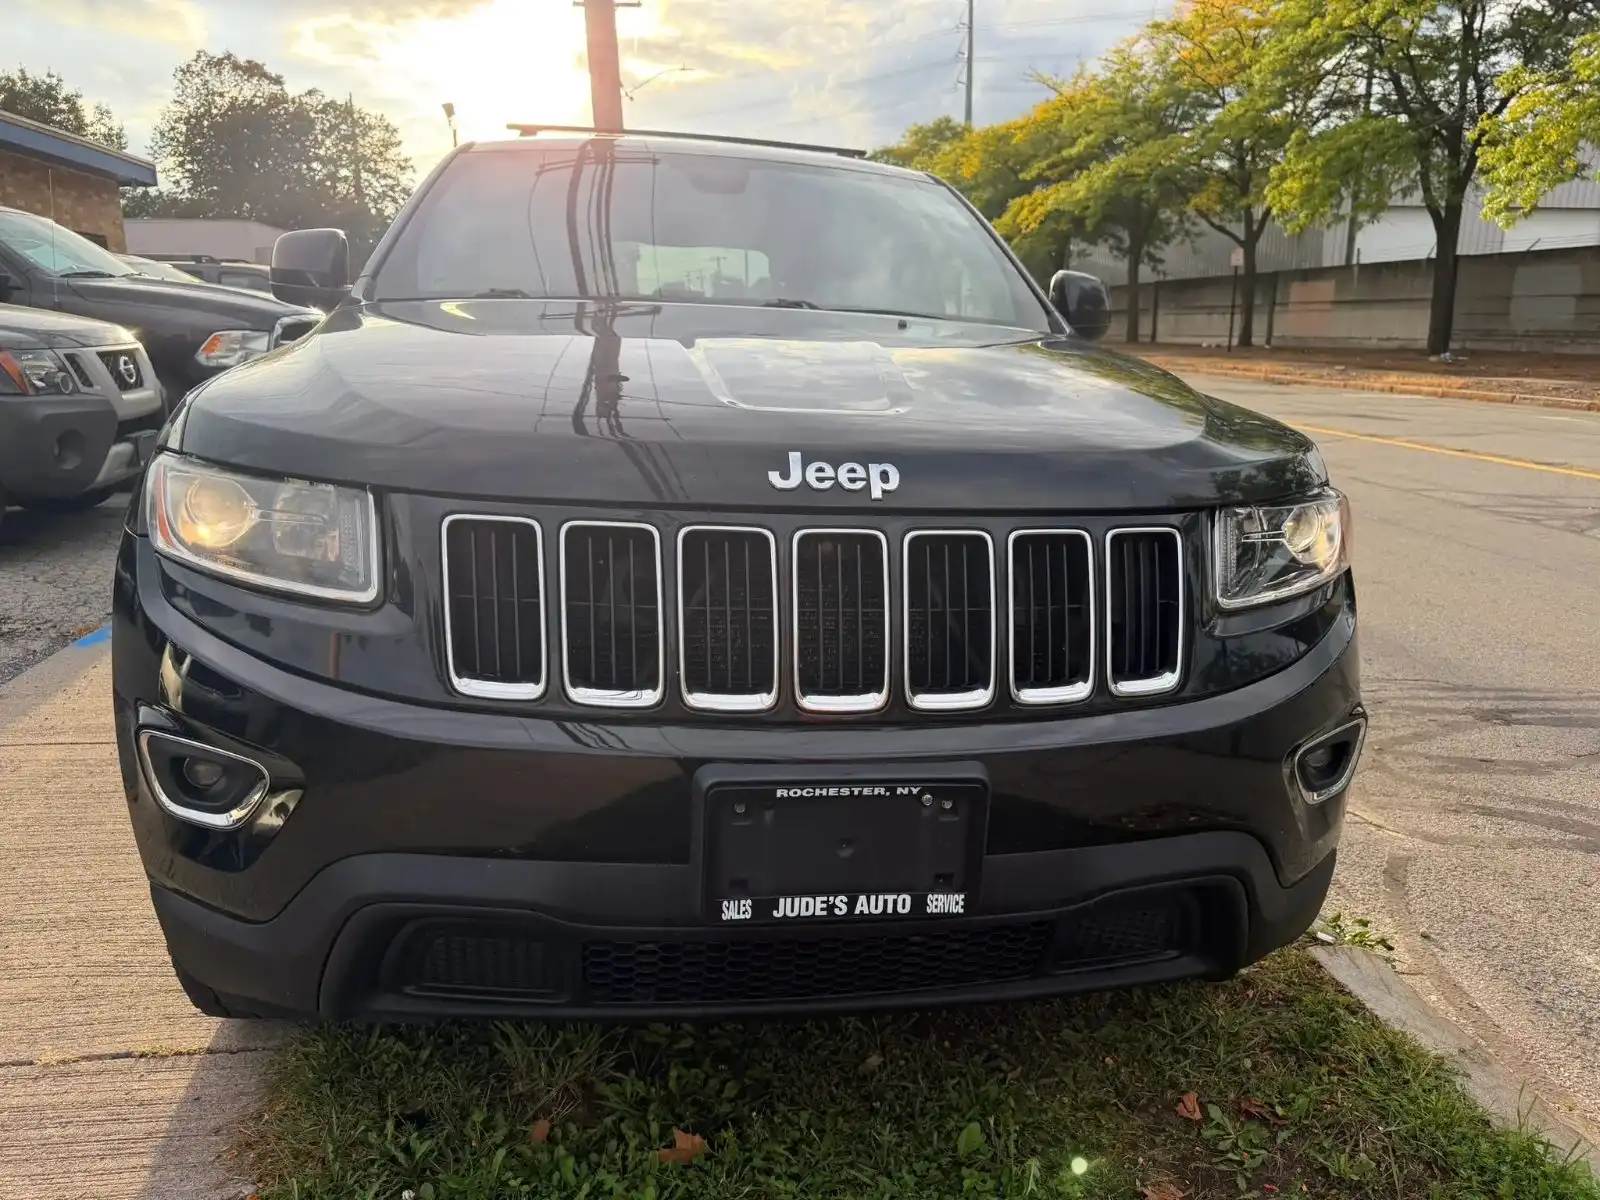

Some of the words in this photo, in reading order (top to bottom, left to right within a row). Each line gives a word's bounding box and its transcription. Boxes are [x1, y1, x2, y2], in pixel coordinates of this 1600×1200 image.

[767, 451, 900, 501] Jeep
[776, 787, 891, 798] ROCHESTER,
[896, 786, 922, 795] NY
[721, 899, 752, 920] SALES
[772, 895, 848, 918] JUDE'S
[854, 894, 912, 914] AUTO
[926, 894, 965, 914] SERVICE
